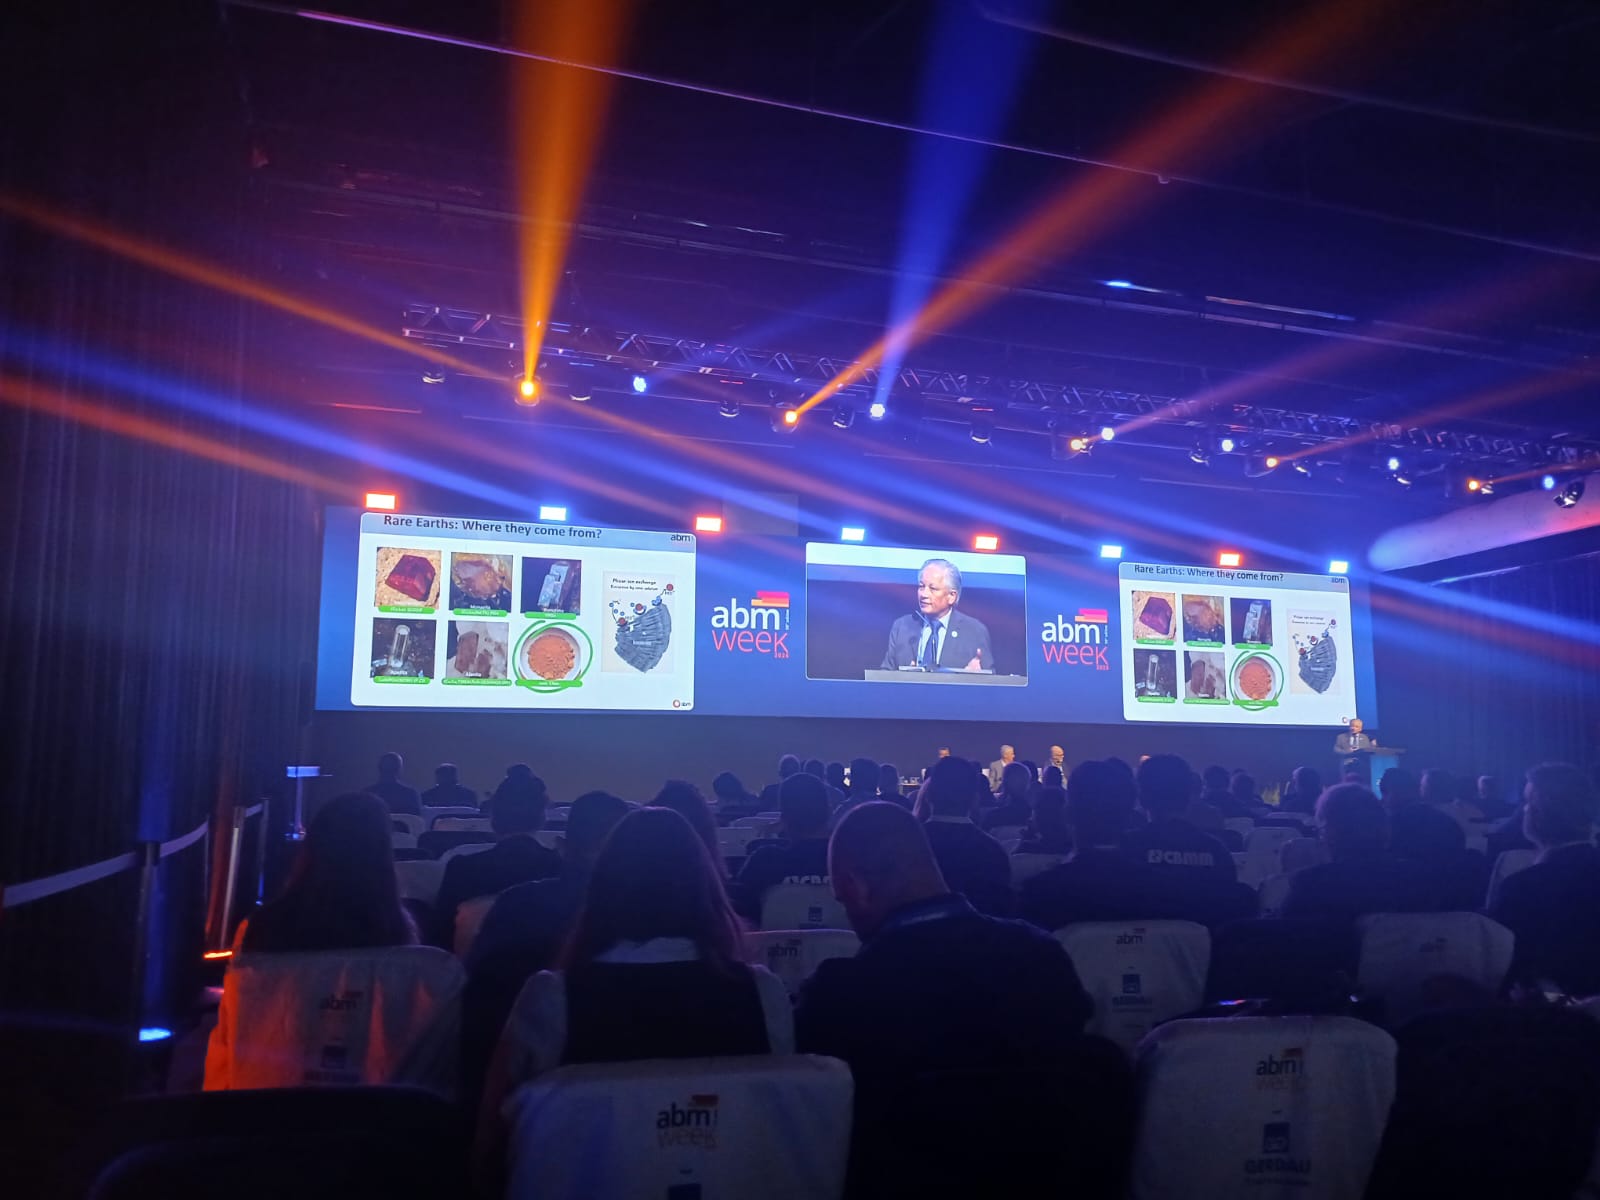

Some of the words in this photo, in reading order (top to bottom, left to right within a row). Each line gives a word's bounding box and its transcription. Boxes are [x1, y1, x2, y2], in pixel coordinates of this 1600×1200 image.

[384, 515, 413, 527] Rare
[416, 517, 458, 530] Earths:
[462, 520, 502, 532] Where
[505, 523, 530, 536] they
[534, 527, 566, 537] come
[568, 527, 602, 539] from?
[670, 533, 691, 542] abm
[1134, 564, 1154, 574] Rare
[1156, 566, 1185, 576] Earths:
[1187, 568, 1214, 578] Where
[1216, 569, 1235, 580] they
[1236, 572, 1258, 580] come
[1260, 573, 1284, 582] from?
[711, 598, 780, 630] abm
[711, 629, 789, 653] week
[1041, 614, 1100, 644] abm
[1042, 643, 1108, 665] week
[1256, 1054, 1297, 1076] abm
[656, 1102, 710, 1129] abm
